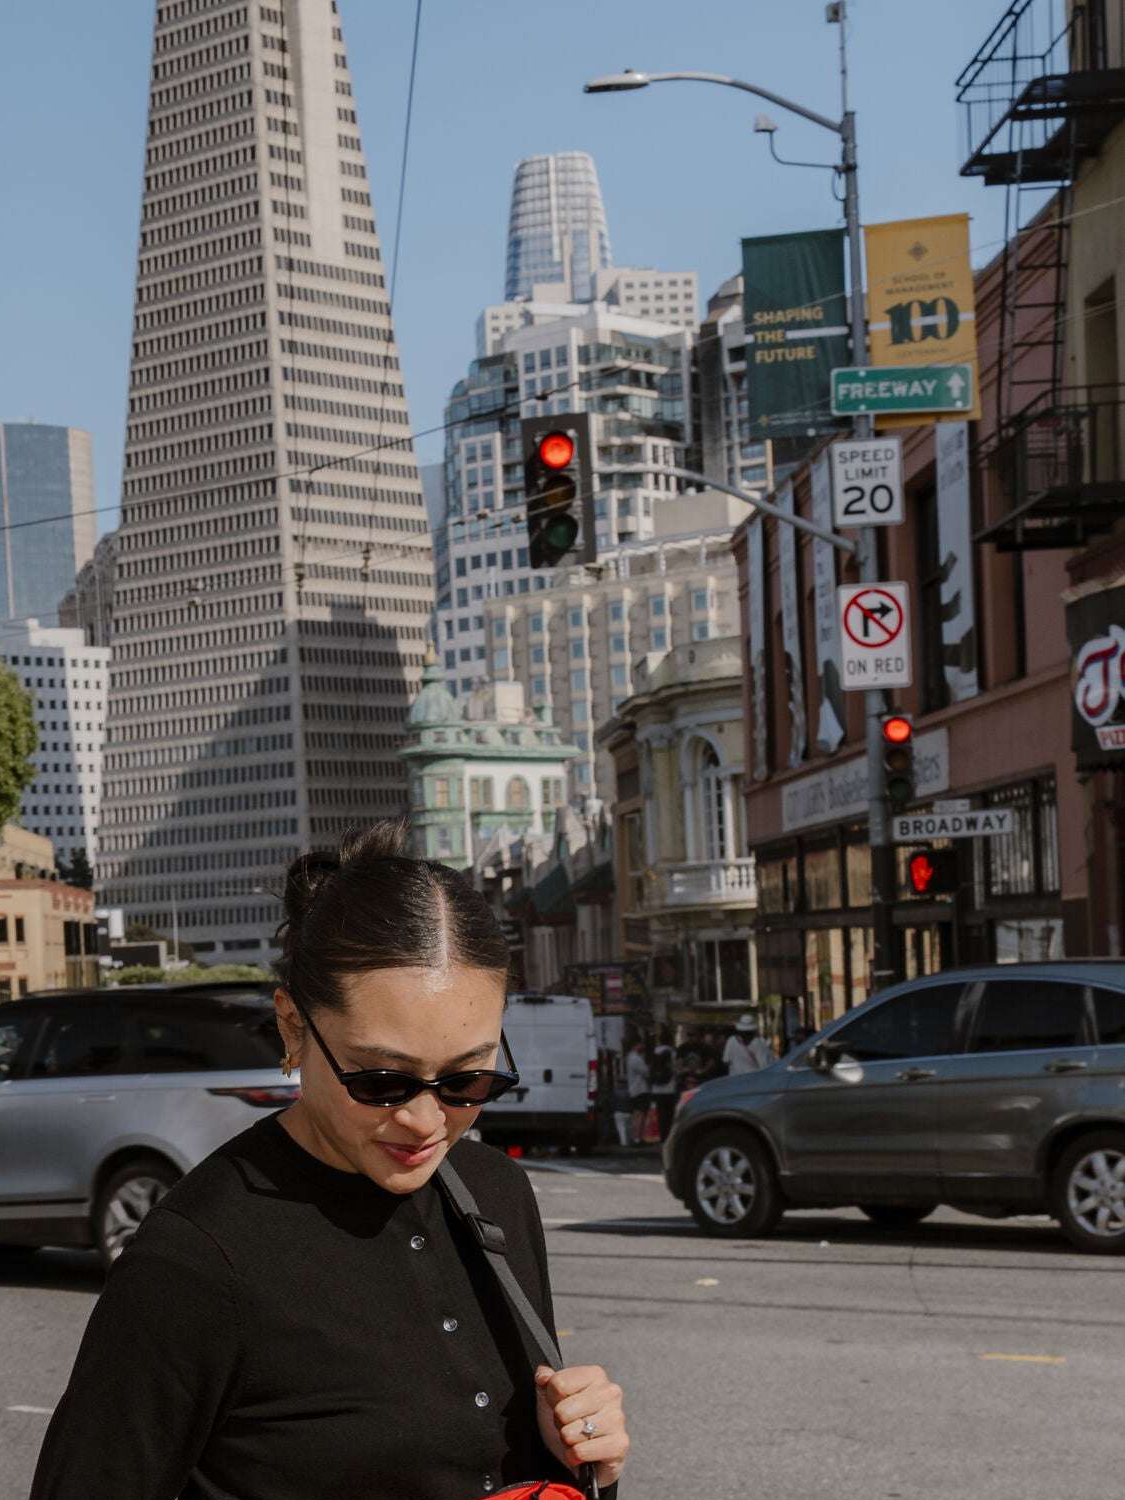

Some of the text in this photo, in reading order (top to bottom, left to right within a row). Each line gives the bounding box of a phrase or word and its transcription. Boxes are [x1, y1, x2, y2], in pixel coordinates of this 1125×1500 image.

[892, 272, 930, 284] SCHOOL
[885, 281, 955, 295] MANAGEMENT
[752, 306, 824, 325] SHAPING
[883, 297, 960, 345] 100
[755, 329, 785, 344] THE
[755, 346, 816, 364] FUTURE
[837, 379, 937, 400] FREEWAY
[838, 448, 895, 464] SPEED
[844, 466, 888, 481] LIMIT
[842, 484, 894, 516] 20
[846, 657, 904, 675] ON RED
[899, 814, 1007, 836] BROADWAY
